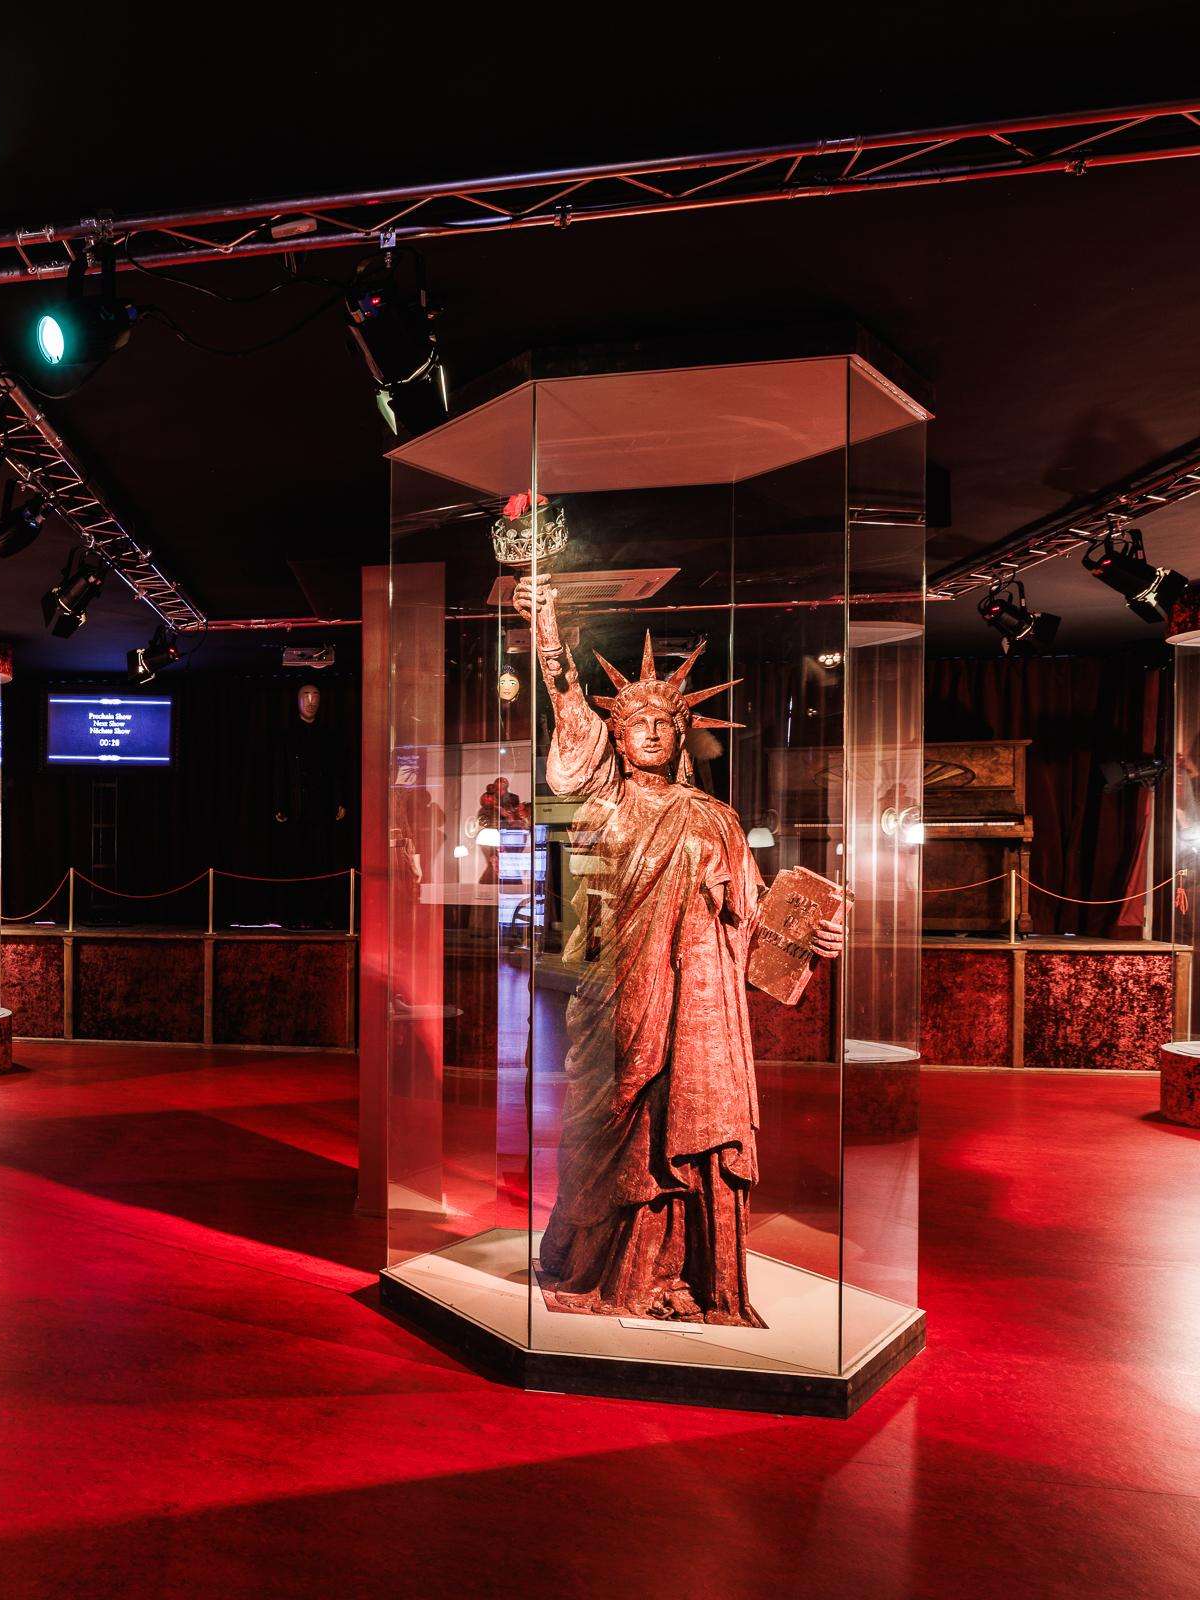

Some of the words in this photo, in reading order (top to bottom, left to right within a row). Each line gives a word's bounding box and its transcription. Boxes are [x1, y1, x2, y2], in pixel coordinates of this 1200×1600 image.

[88, 712, 115, 720] Prochain
[115, 713, 132, 721] Show
[113, 727, 131, 735] Show
